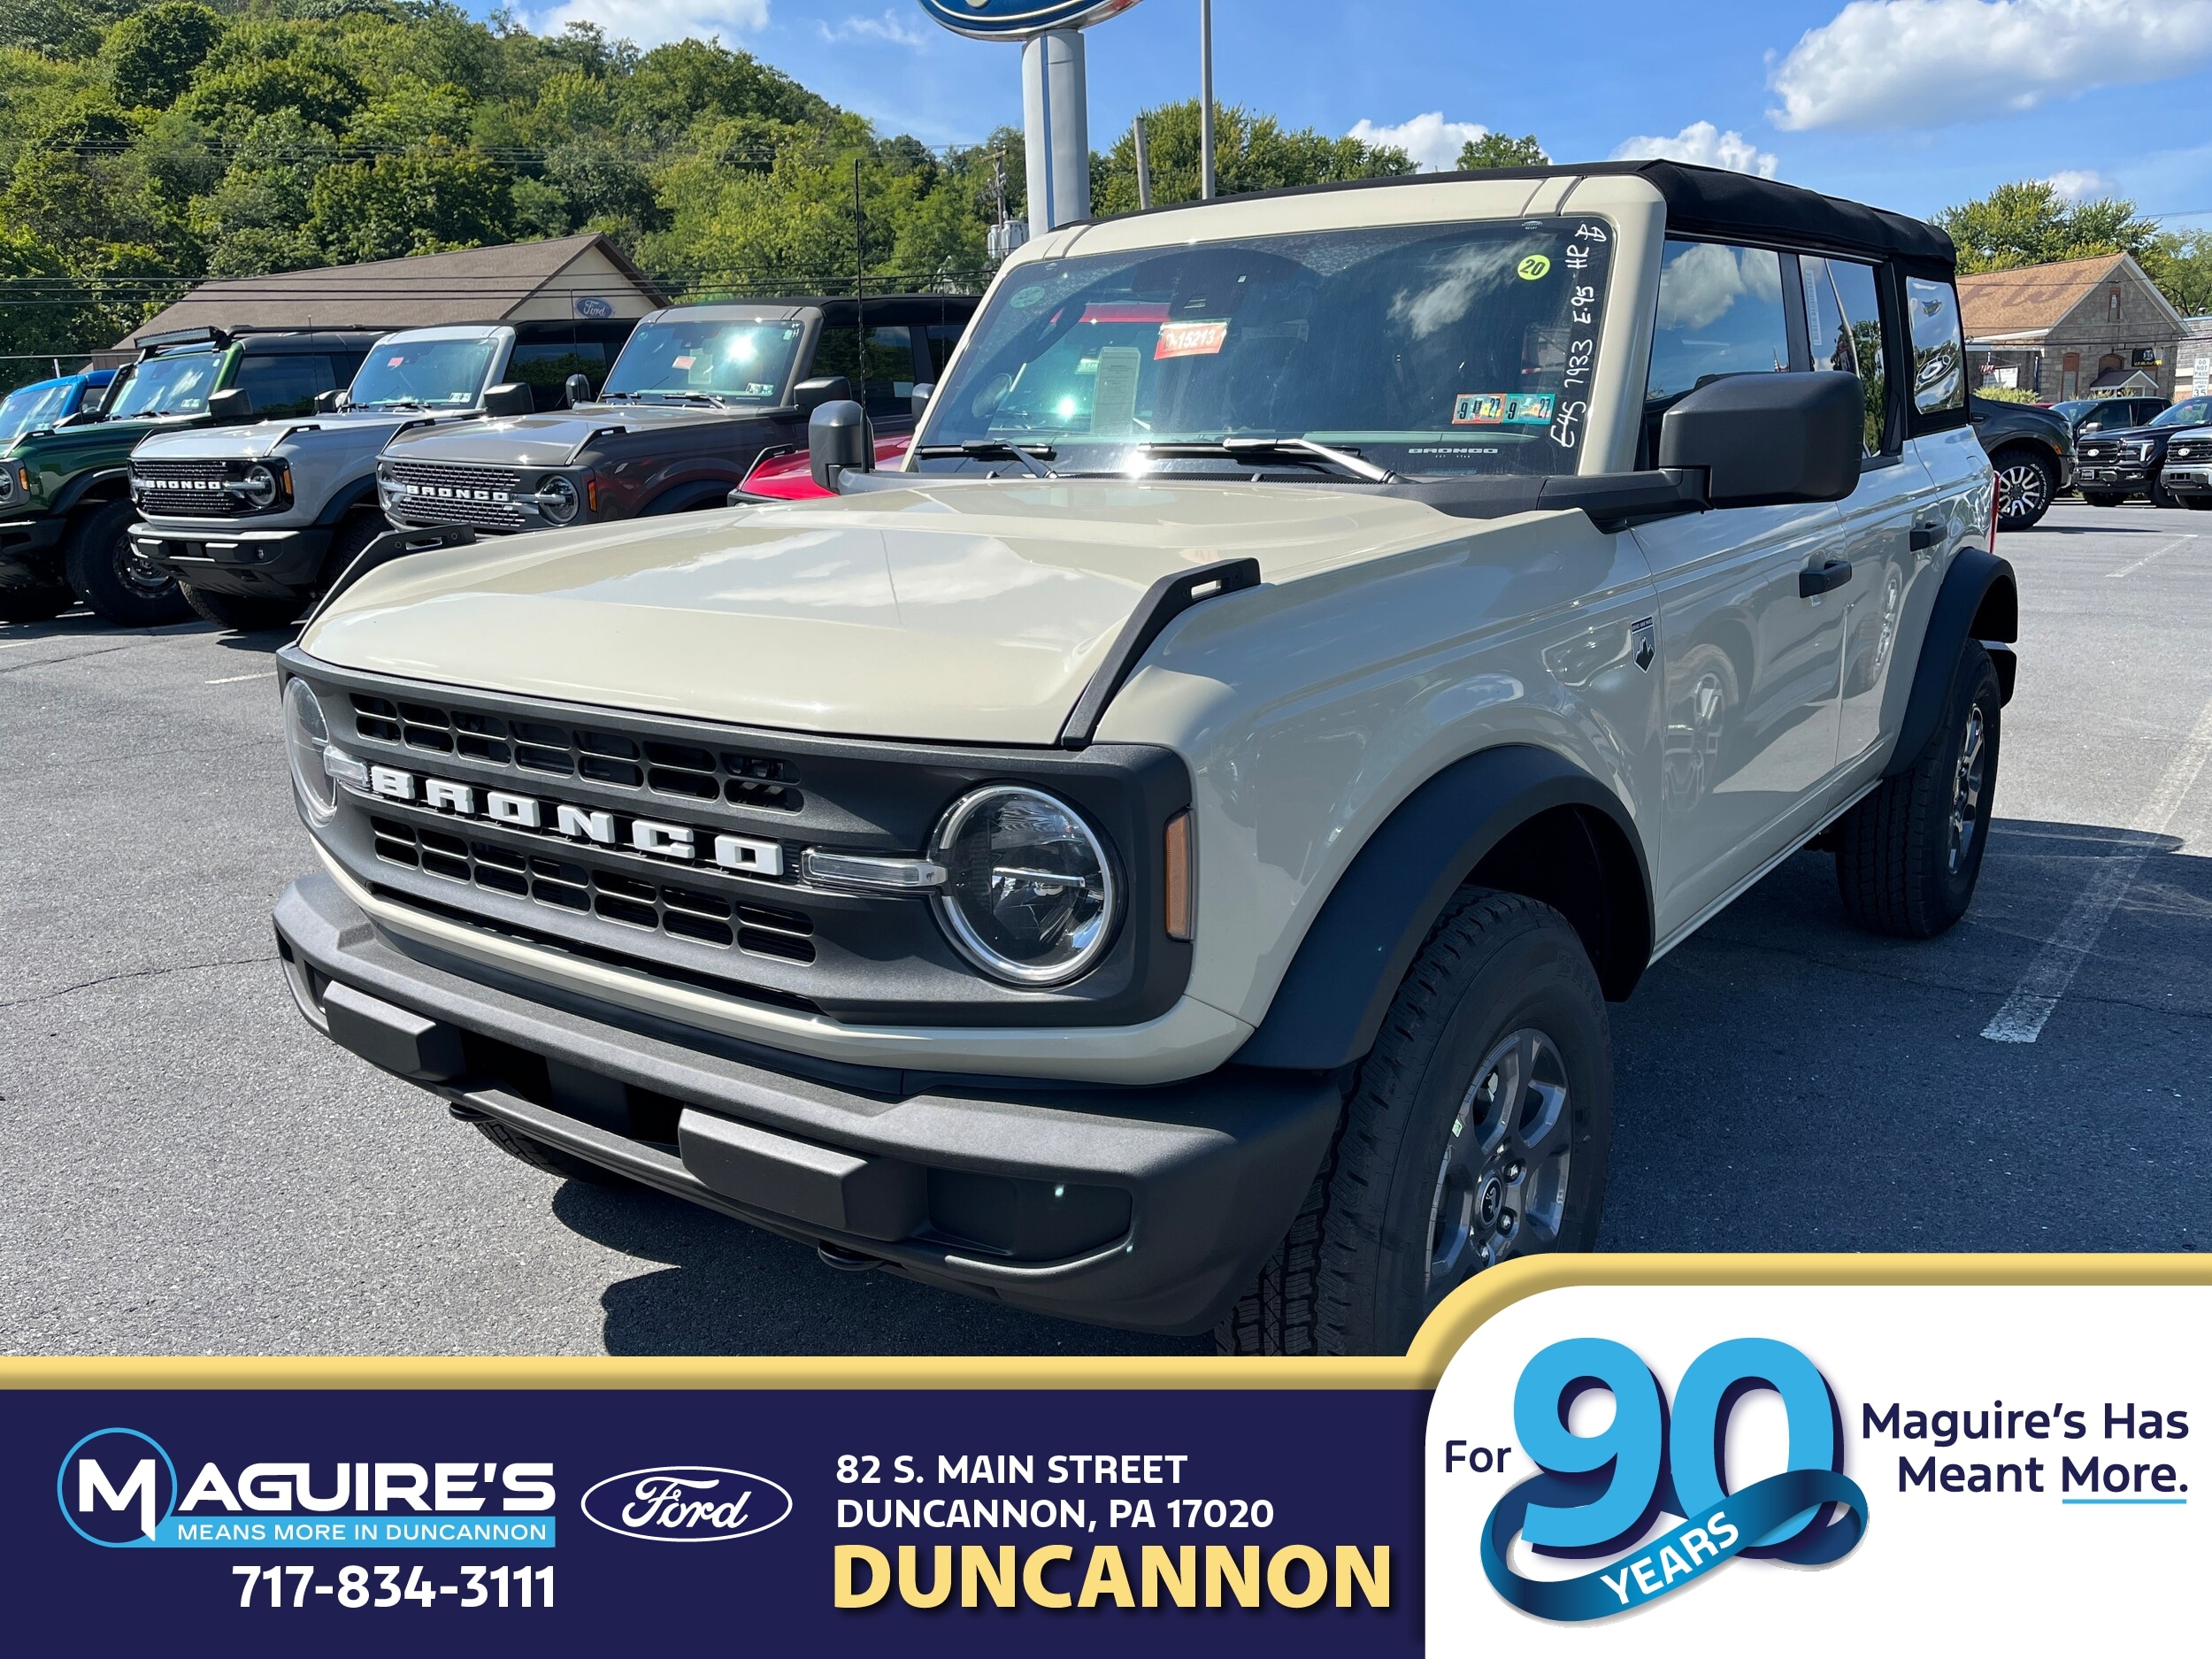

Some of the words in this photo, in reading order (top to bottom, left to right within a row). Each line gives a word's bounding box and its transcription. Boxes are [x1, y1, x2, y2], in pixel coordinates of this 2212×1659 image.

[1519, 258, 1547, 276] 20
[583, 299, 606, 317] Ford
[1459, 402, 1469, 419] 9
[1487, 397, 1501, 419] 27
[1507, 402, 1517, 419] 9
[1538, 398, 1551, 419] 27
[145, 480, 221, 490] BRONCO
[406, 485, 510, 502] BRONCO
[371, 764, 783, 878] BRONCO
